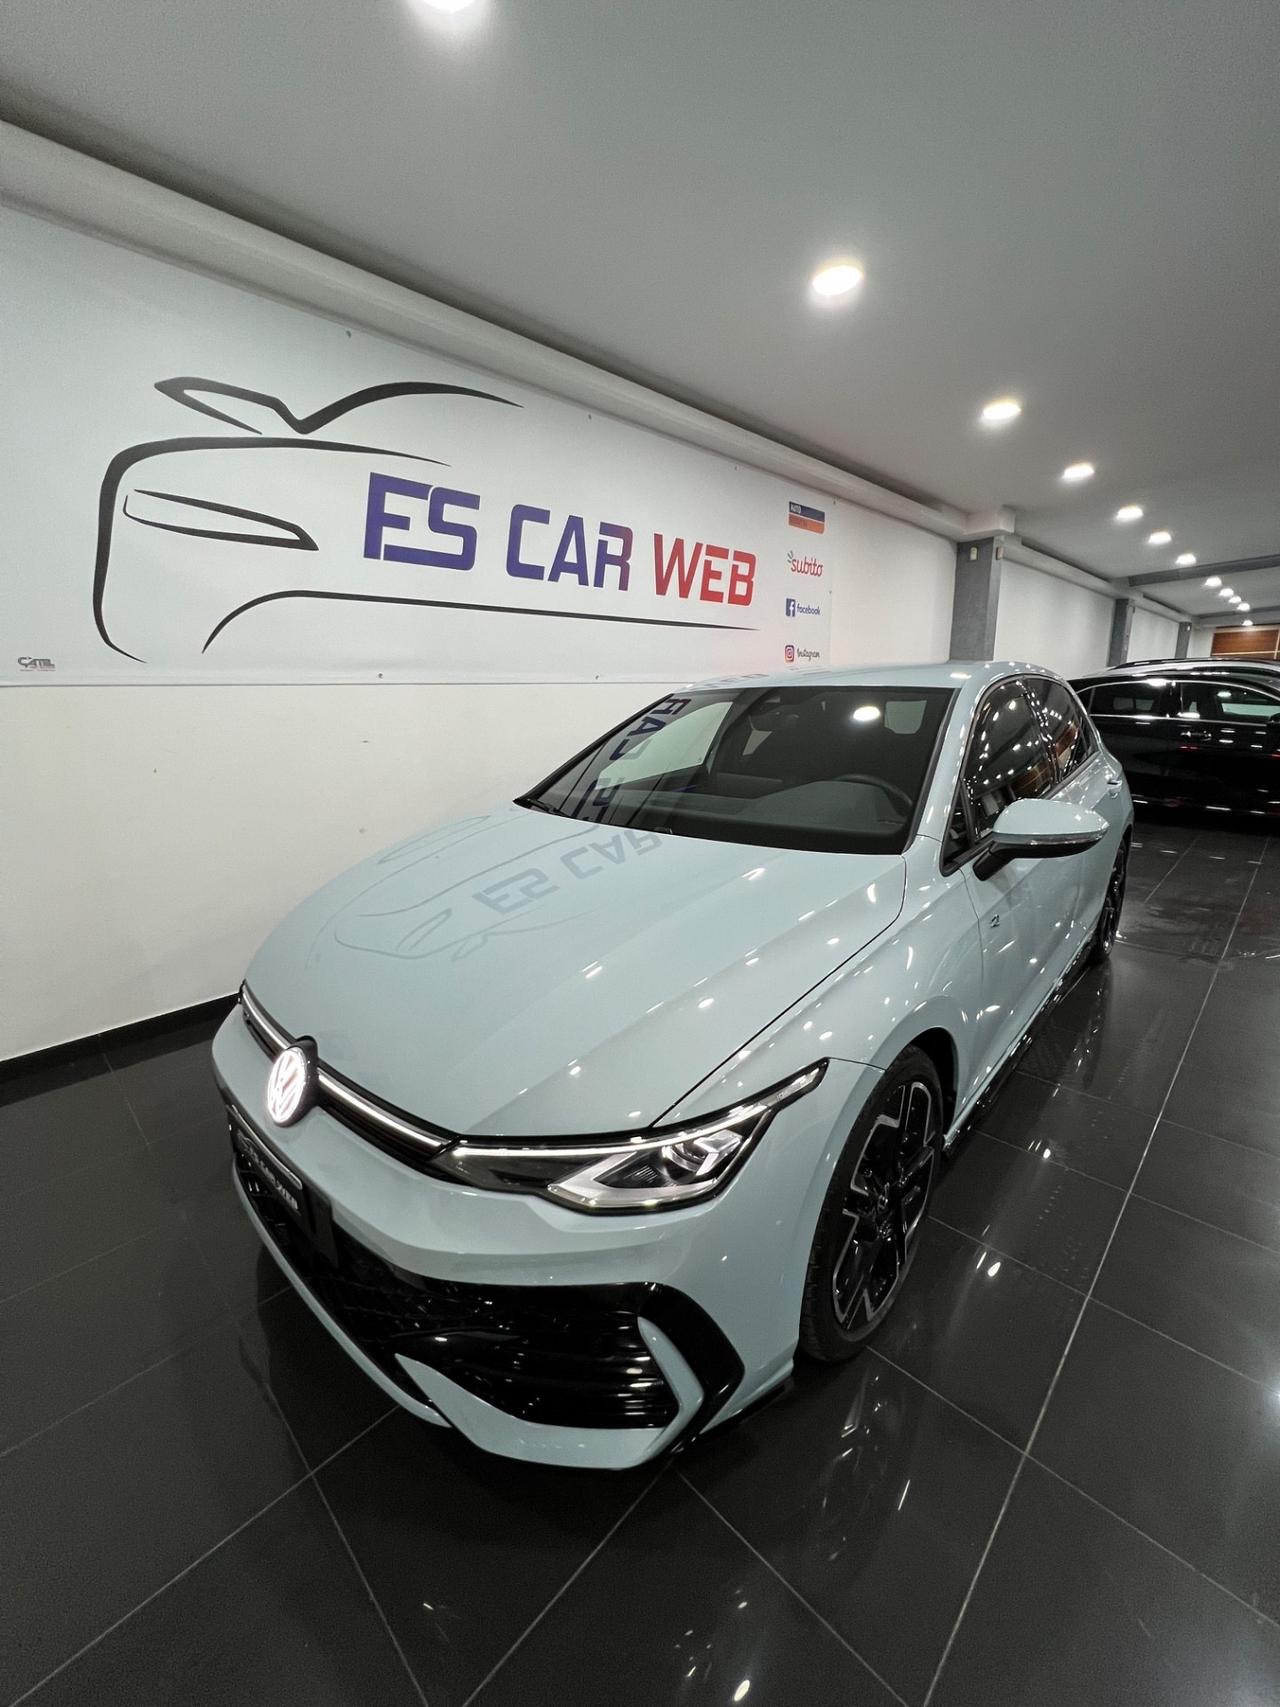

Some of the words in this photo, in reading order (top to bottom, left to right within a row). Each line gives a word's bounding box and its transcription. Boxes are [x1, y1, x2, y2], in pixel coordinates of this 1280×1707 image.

[363, 472, 481, 571] ES
[506, 504, 633, 591] CAR
[653, 533, 757, 606] WEB
[791, 555, 823, 577] subito
[797, 603, 820, 615] facebook
[797, 648, 820, 661] Instagram
